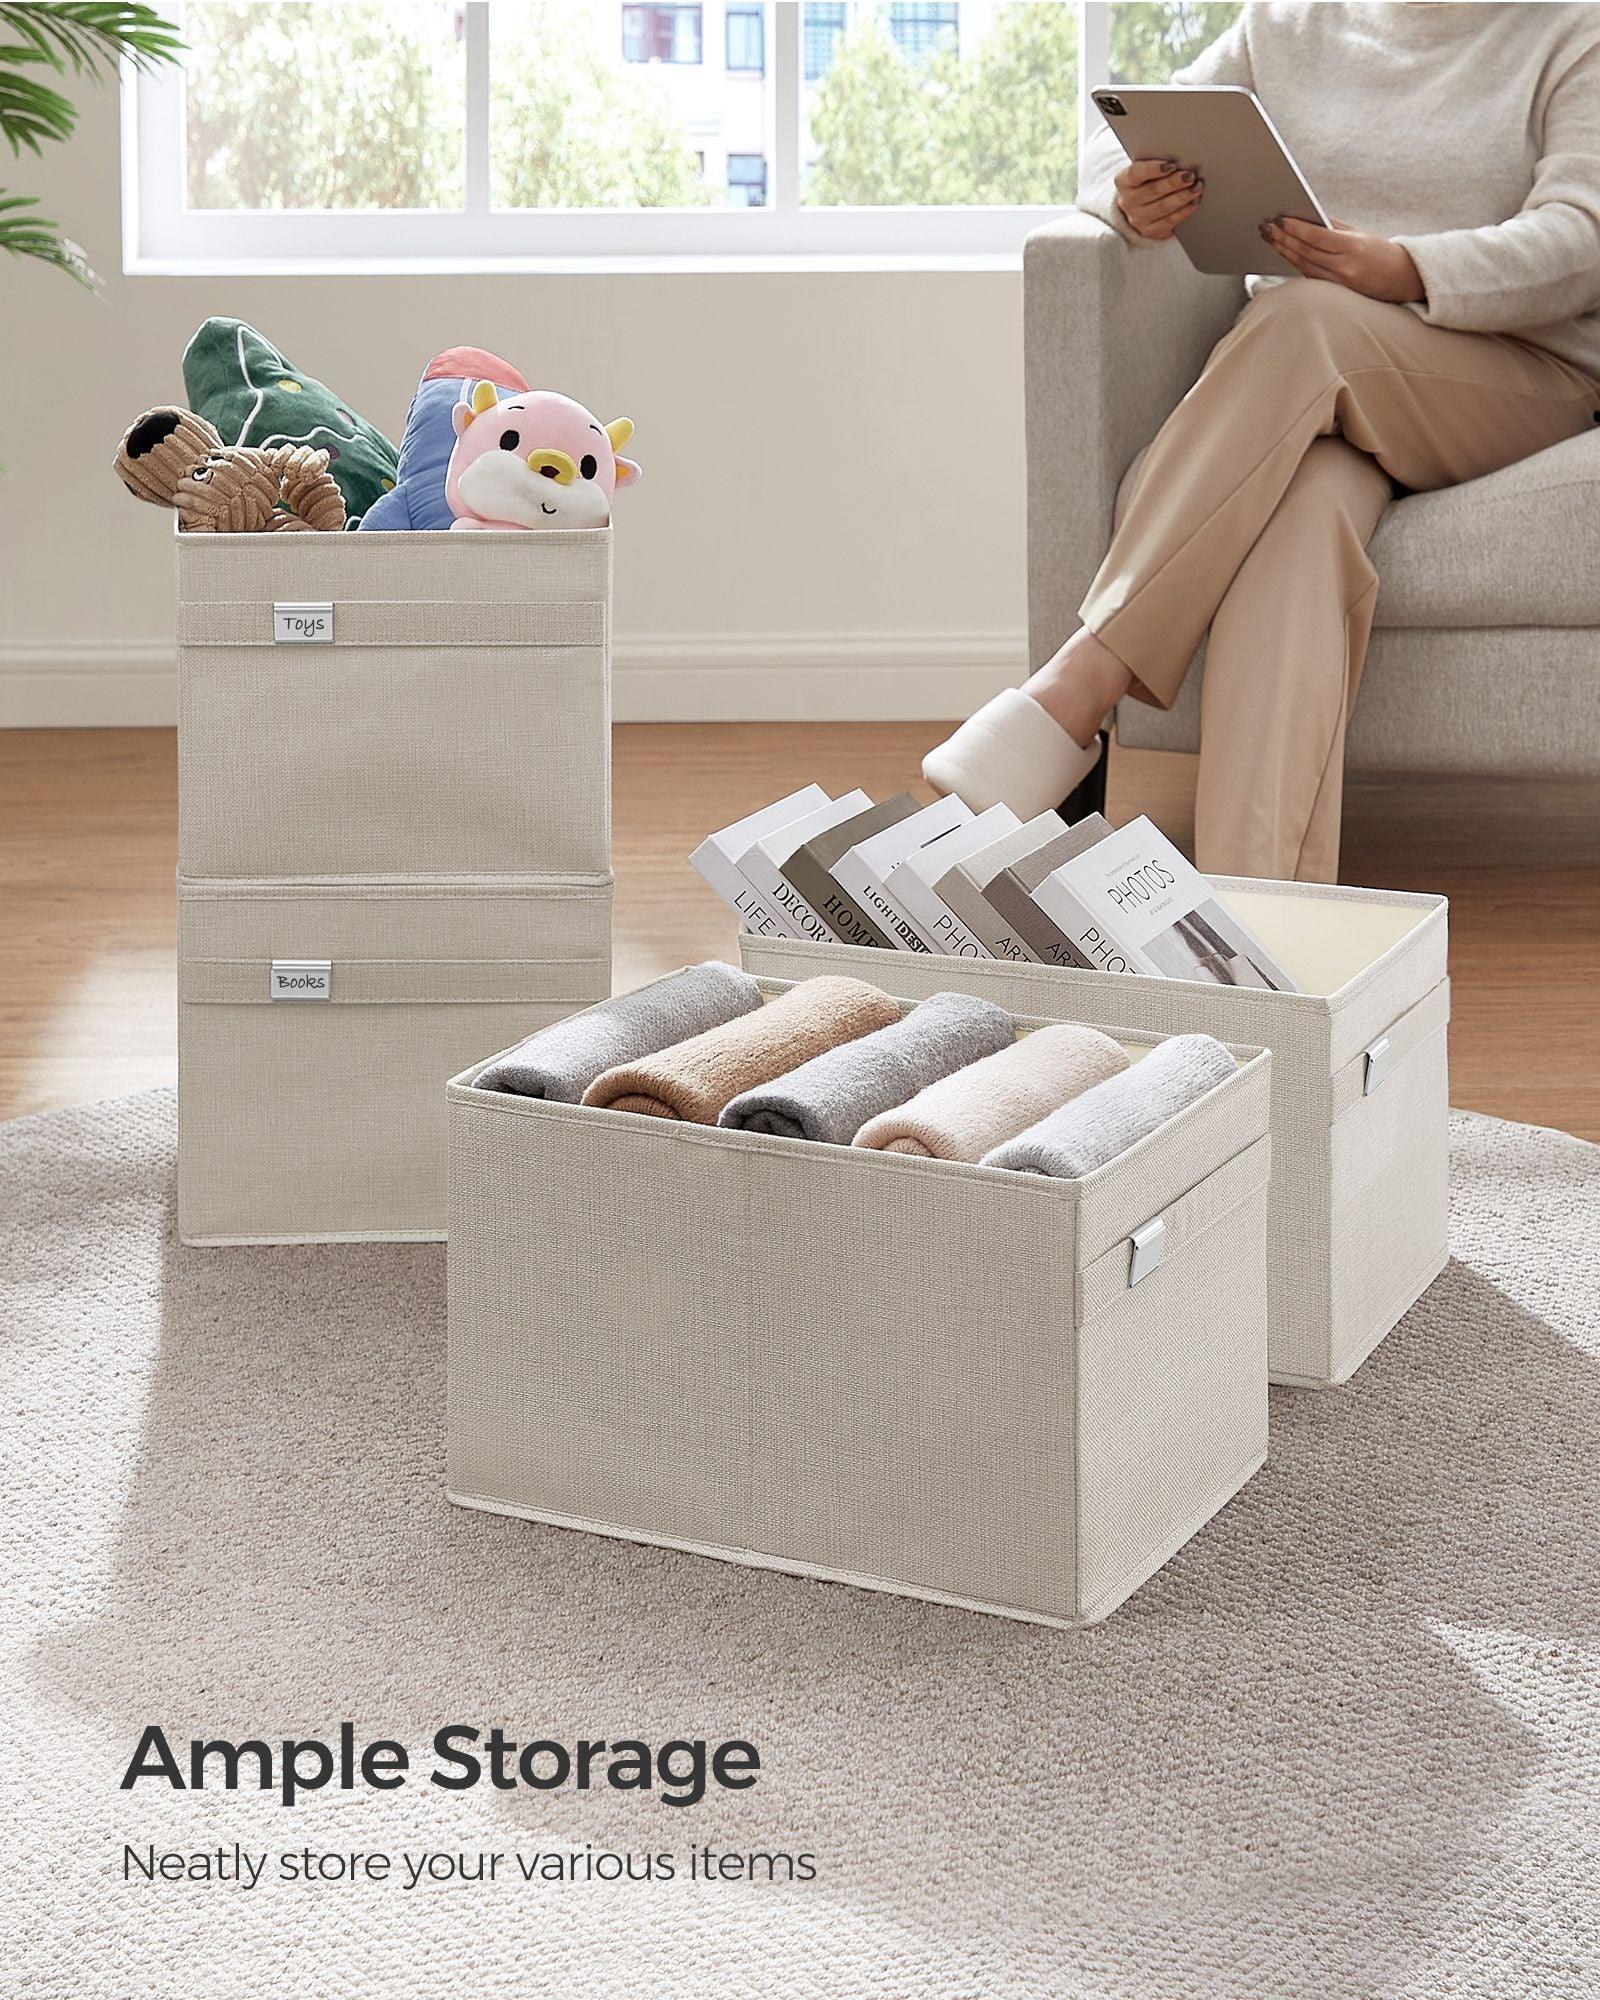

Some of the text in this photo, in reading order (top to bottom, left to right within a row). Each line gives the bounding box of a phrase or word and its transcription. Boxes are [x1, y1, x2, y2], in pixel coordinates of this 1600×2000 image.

[283, 617, 324, 637] Toys
[1107, 859, 1175, 914] PHOTOS
[734, 890, 776, 936] LIFE
[933, 914, 986, 959] PHO
[1079, 926, 1136, 974] PHO
[277, 974, 325, 988] Books
